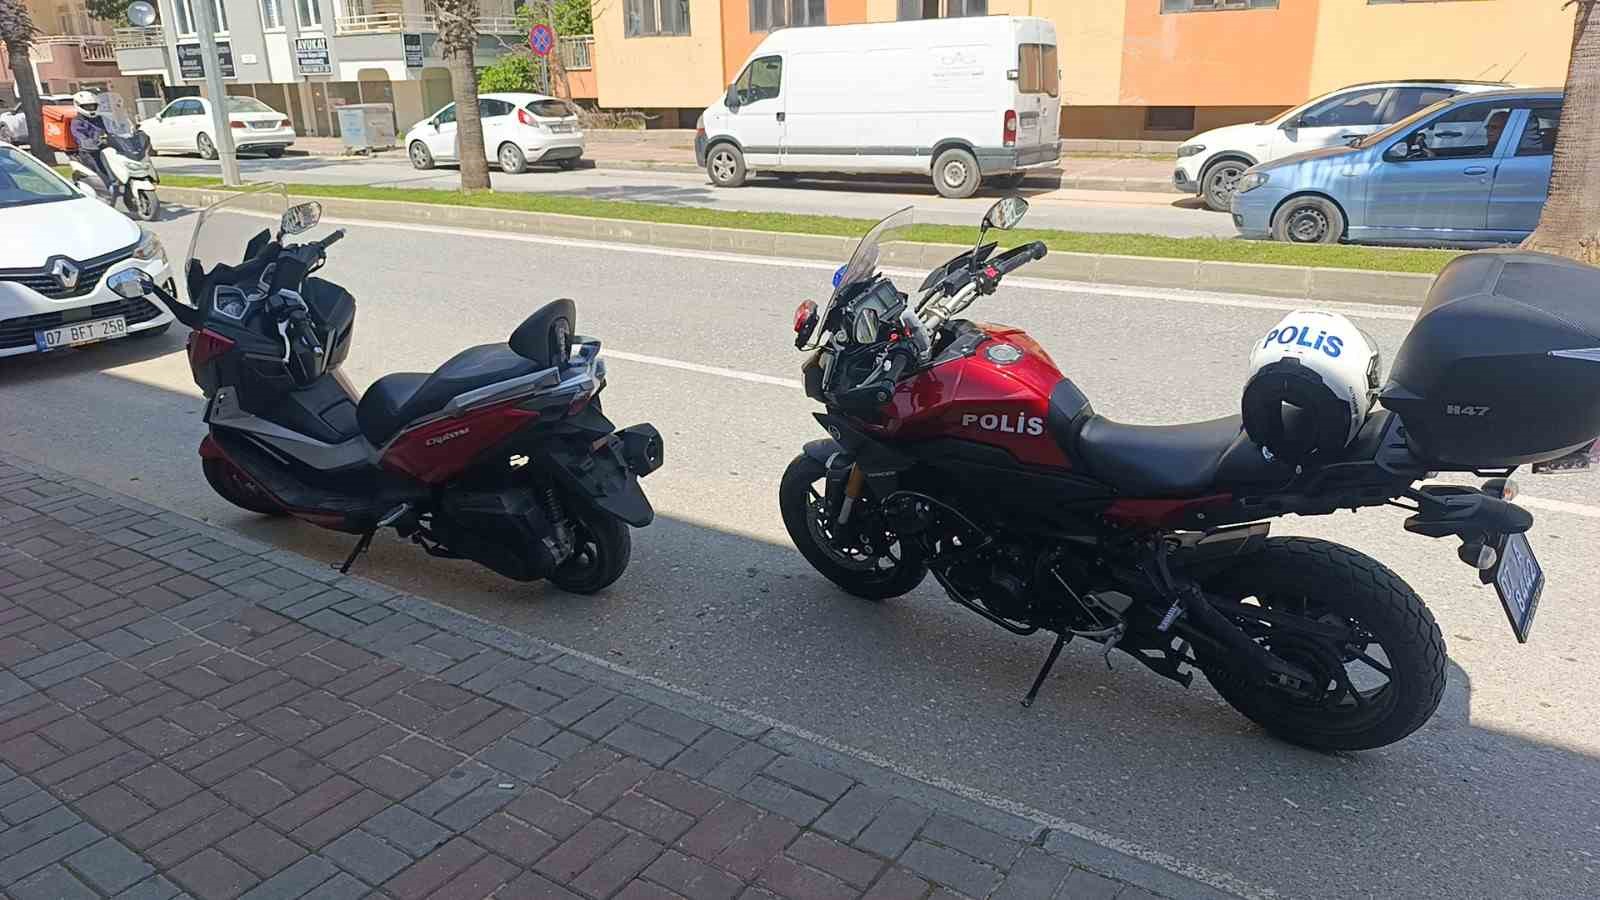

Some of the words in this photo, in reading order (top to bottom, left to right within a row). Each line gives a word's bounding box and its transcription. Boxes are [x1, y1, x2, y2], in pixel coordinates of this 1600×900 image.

[46, 330, 61, 346] 07
[70, 324, 94, 341] BFT
[102, 319, 124, 335] 258
[1446, 404, 1490, 416] H47
